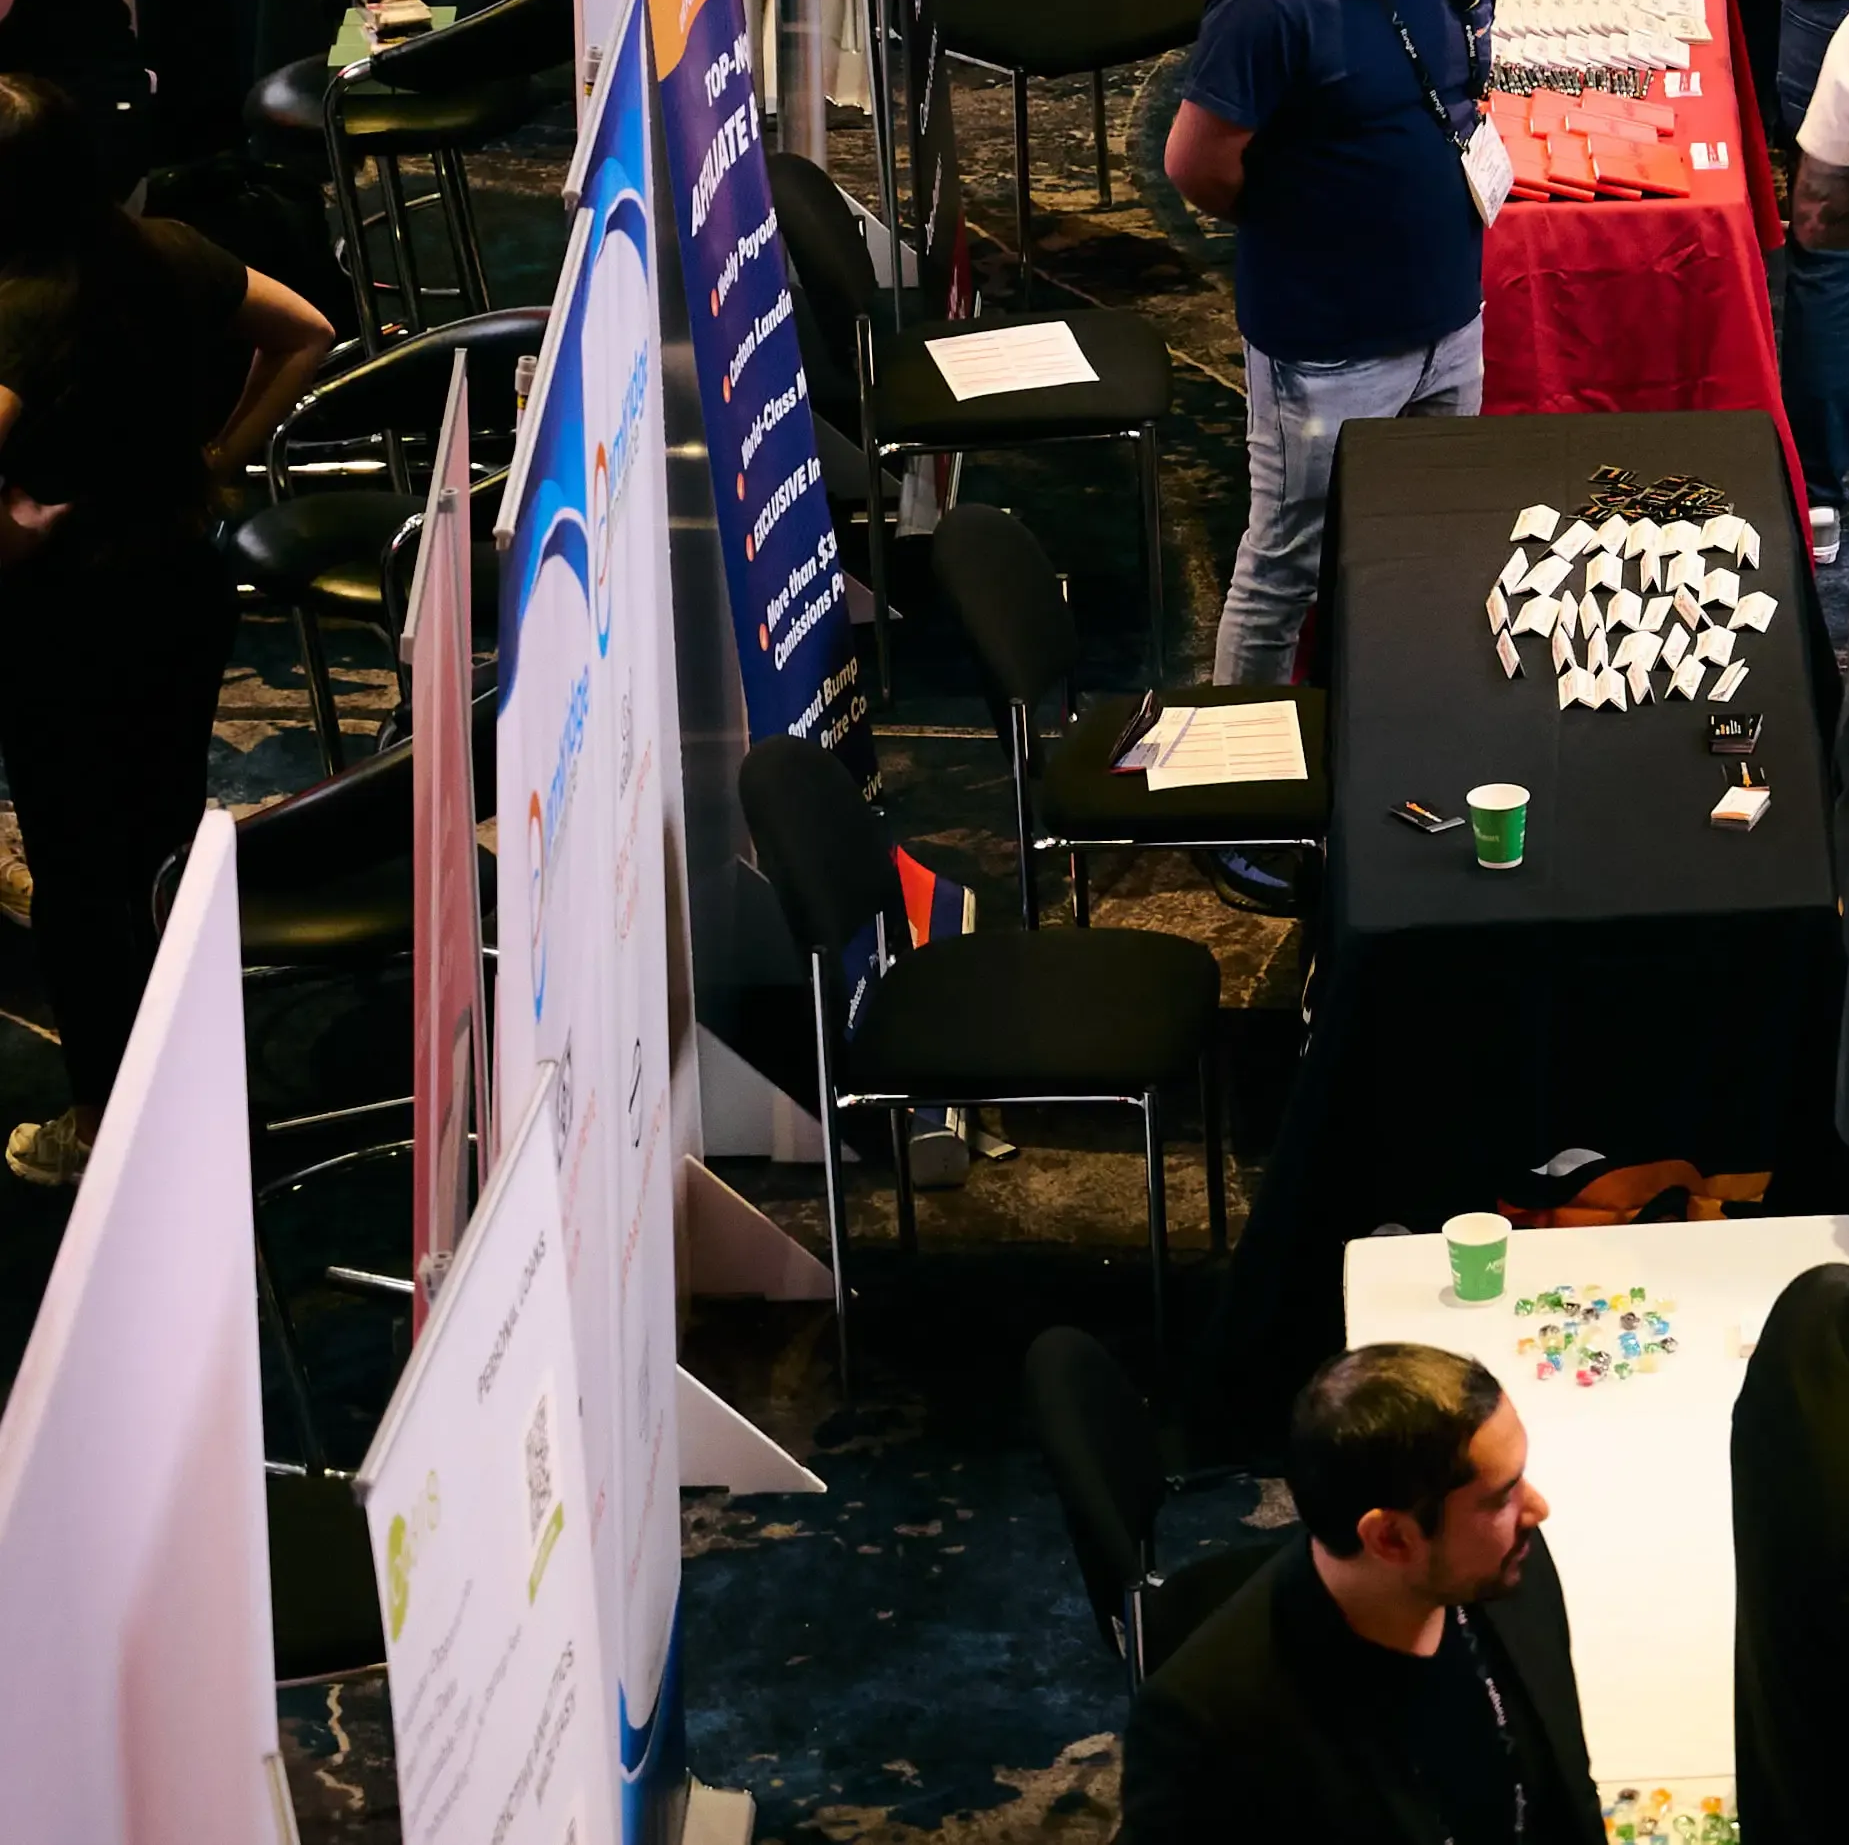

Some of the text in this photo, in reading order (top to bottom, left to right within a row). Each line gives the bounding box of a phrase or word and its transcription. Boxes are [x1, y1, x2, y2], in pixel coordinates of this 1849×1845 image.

[1400, 27, 1417, 59] Ringba
[691, 104, 748, 237] AFFILIATE
[738, 207, 778, 267] Payouts
[729, 289, 793, 387] Custom Landin
[741, 387, 797, 469] World-Class
[752, 466, 807, 552] EXCLUSIVE
[766, 592, 790, 634] More
[788, 561, 817, 603] than
[774, 591, 831, 672] Comissions
[822, 655, 859, 703] Bump
[849, 691, 867, 724] Co
